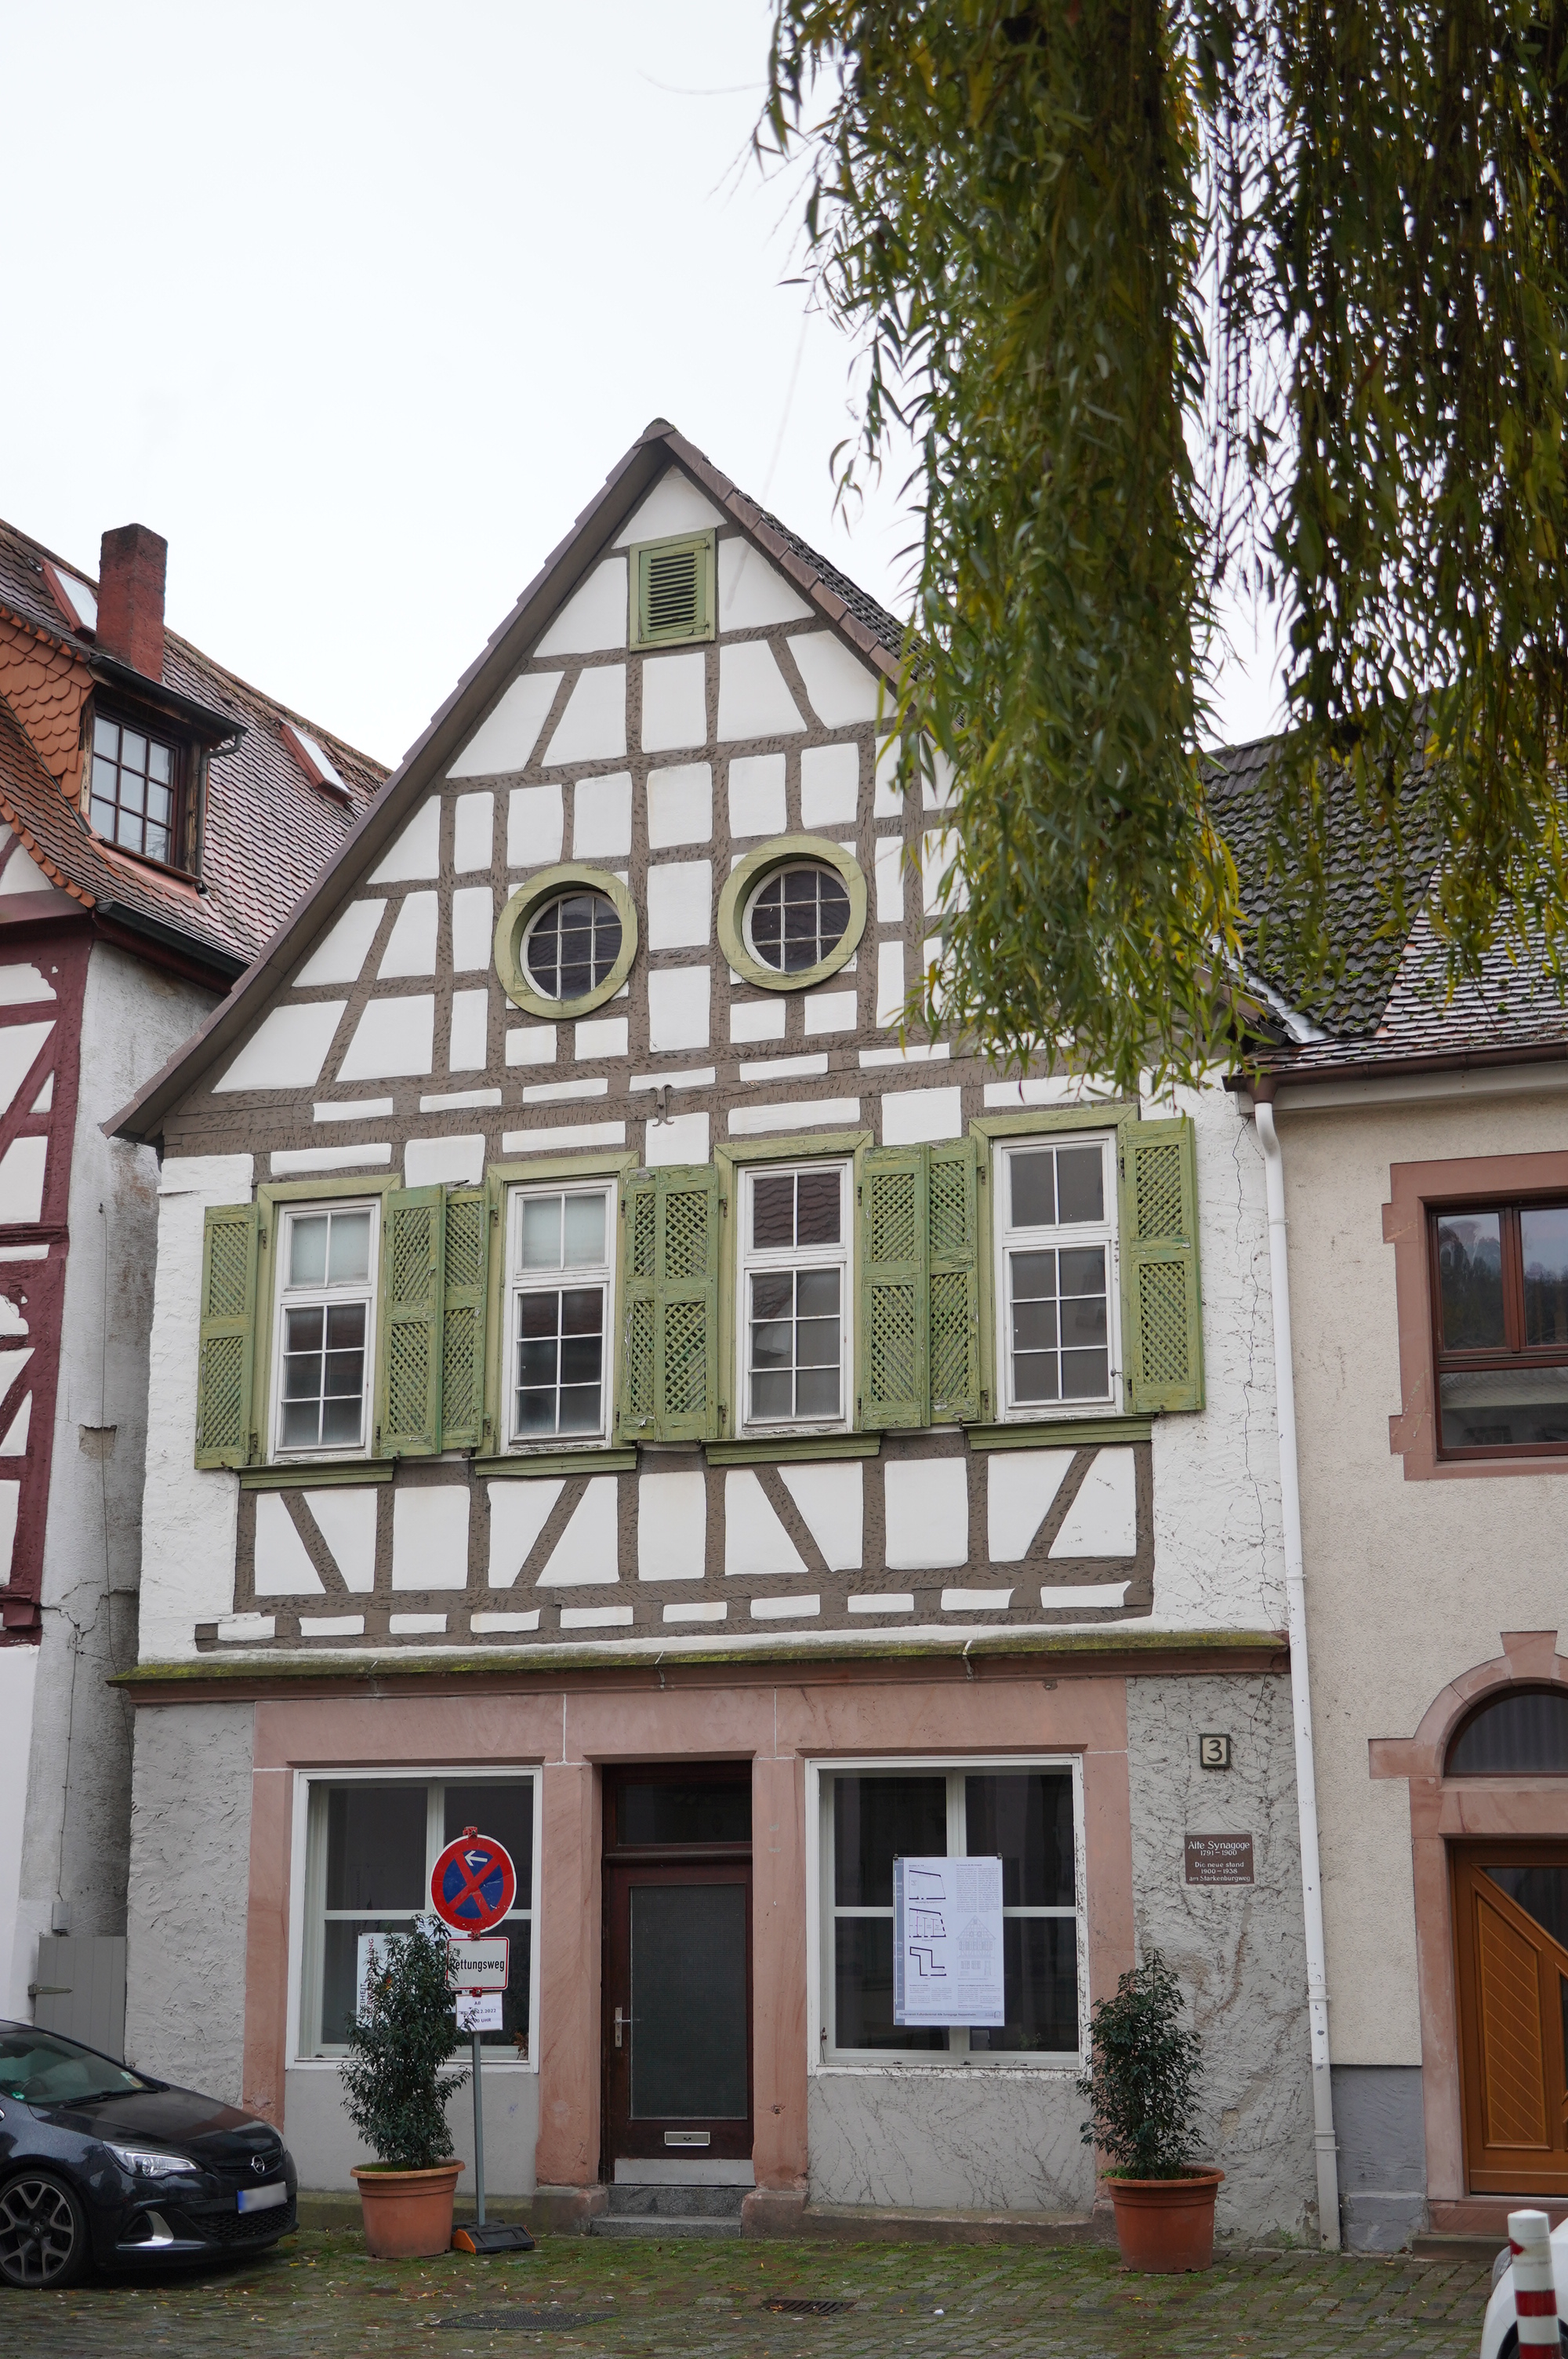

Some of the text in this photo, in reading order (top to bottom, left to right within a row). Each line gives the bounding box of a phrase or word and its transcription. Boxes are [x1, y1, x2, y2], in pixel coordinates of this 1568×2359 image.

[1207, 1739, 1222, 1762] 3
[1188, 1841, 1250, 1851] Alte Synagoge
